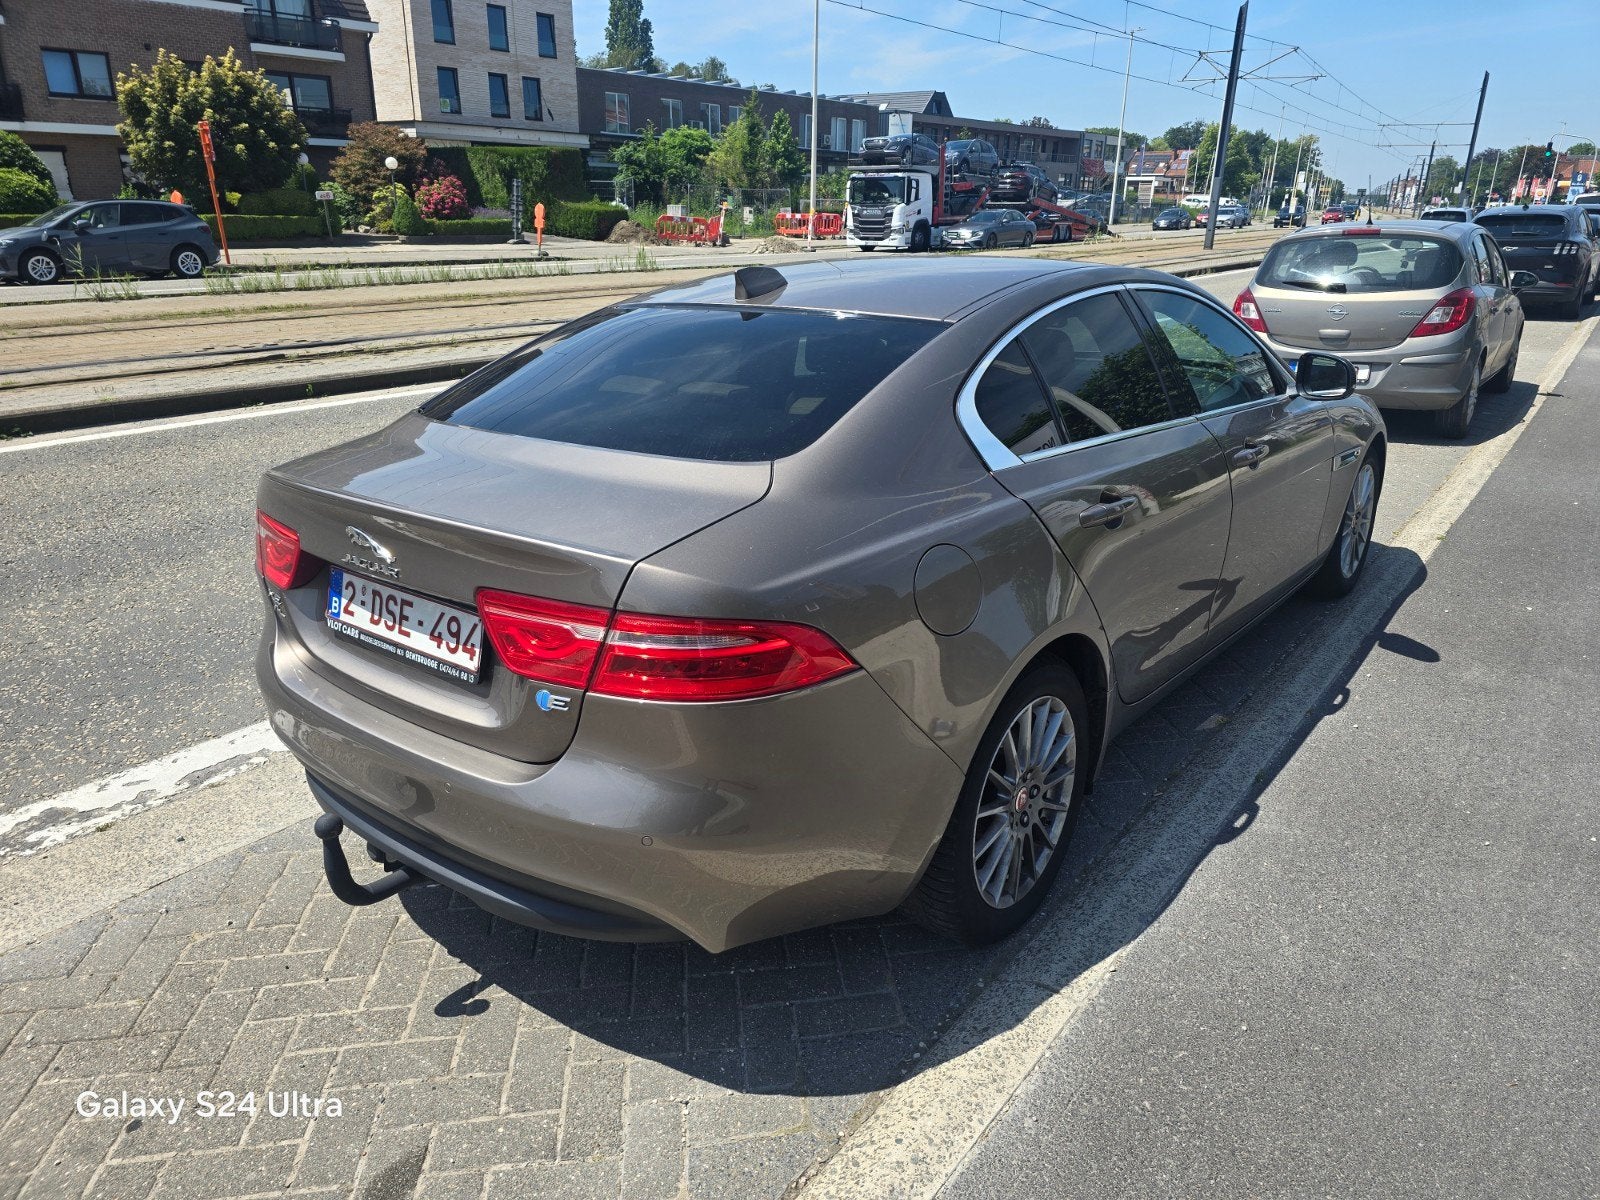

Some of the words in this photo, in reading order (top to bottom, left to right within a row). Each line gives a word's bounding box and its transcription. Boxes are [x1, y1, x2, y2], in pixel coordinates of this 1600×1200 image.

[331, 596, 339, 614] B
[327, 618, 342, 631] VLOT
[342, 625, 359, 639] CARS
